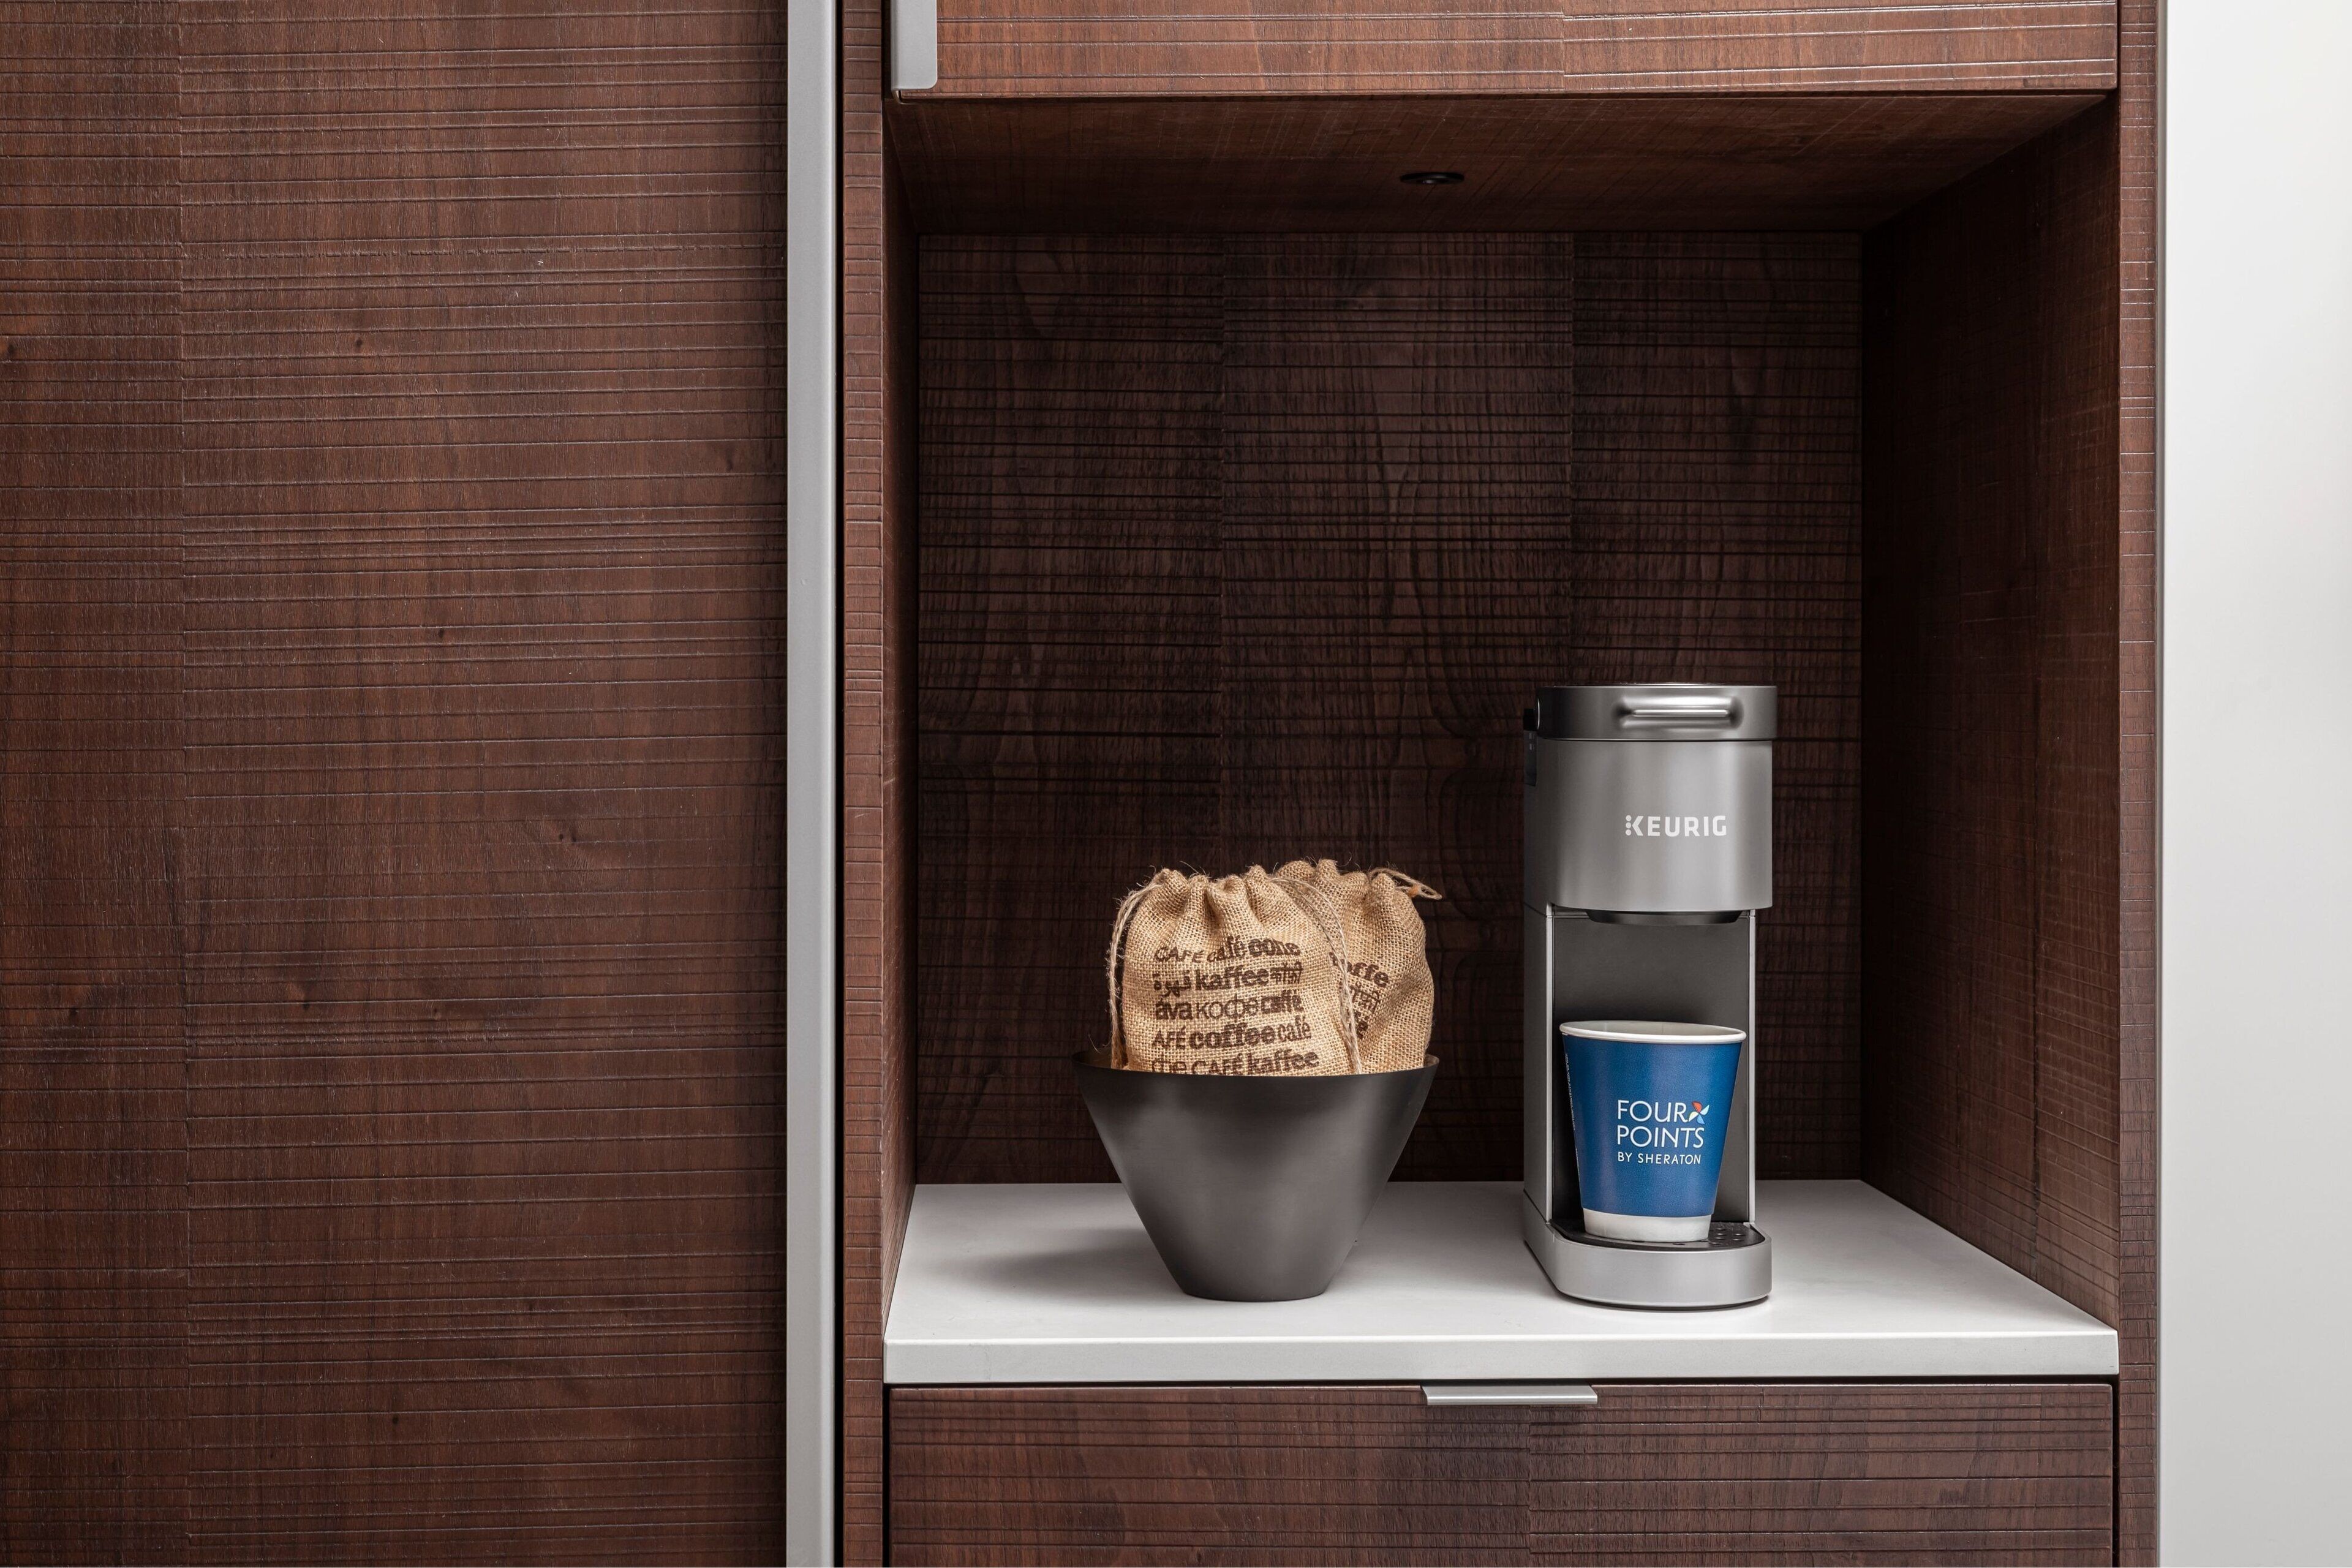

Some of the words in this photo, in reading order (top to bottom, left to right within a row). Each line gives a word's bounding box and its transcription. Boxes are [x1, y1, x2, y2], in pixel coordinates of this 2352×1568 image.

[1625, 815, 1727, 837] KEURIG
[1195, 965, 1269, 990] kaffee
[1188, 1022, 1276, 1050] coffee
[1276, 1014, 1311, 1041] café
[1247, 1049, 1319, 1073] kaffee
[1617, 1099, 1688, 1123] FOUR
[1617, 1125, 1705, 1148] POINTS
[1618, 1152, 1633, 1163] BY
[1638, 1153, 1702, 1164] SHERATON
